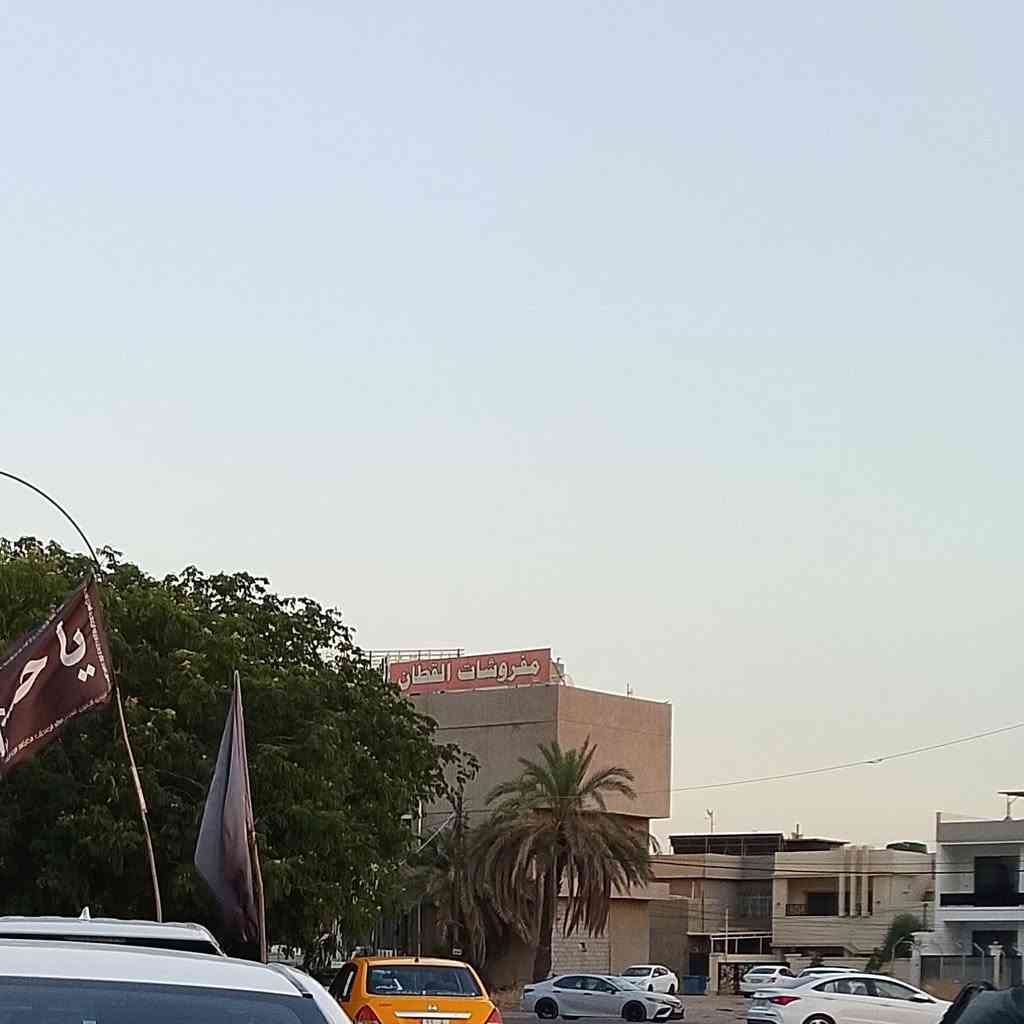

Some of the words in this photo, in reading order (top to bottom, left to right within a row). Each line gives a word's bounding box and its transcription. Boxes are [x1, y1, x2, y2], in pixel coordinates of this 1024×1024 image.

[56, 620, 96, 683] يا
[398, 661, 452, 691] القطان
[457, 655, 541, 682] مفروشات
